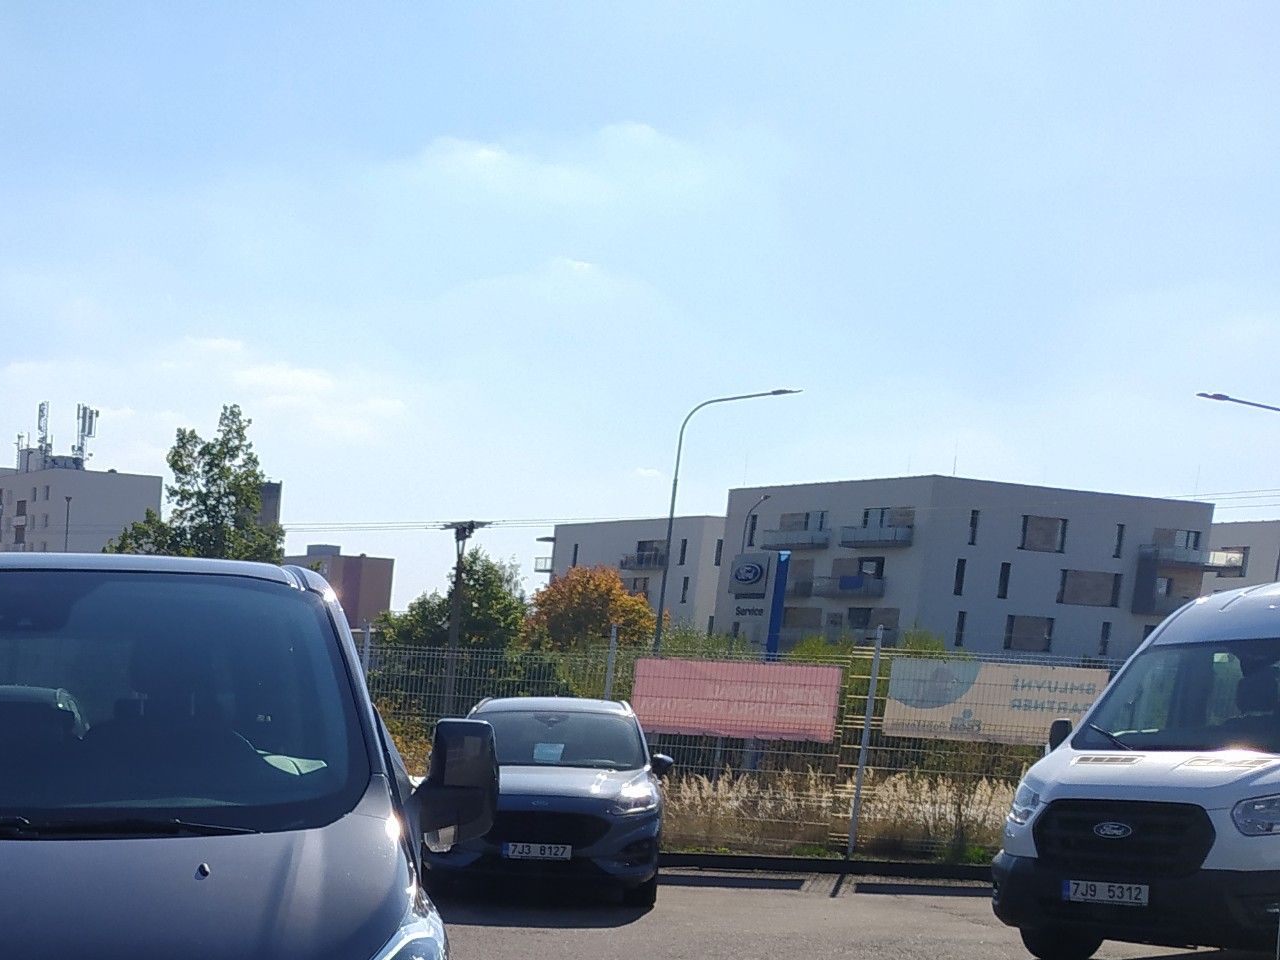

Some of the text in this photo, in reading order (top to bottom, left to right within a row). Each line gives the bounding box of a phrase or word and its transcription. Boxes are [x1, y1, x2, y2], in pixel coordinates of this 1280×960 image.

[735, 606, 764, 616] Service
[511, 844, 567, 857] 7J3 8127
[1072, 882, 1142, 900] 7J9 5312
